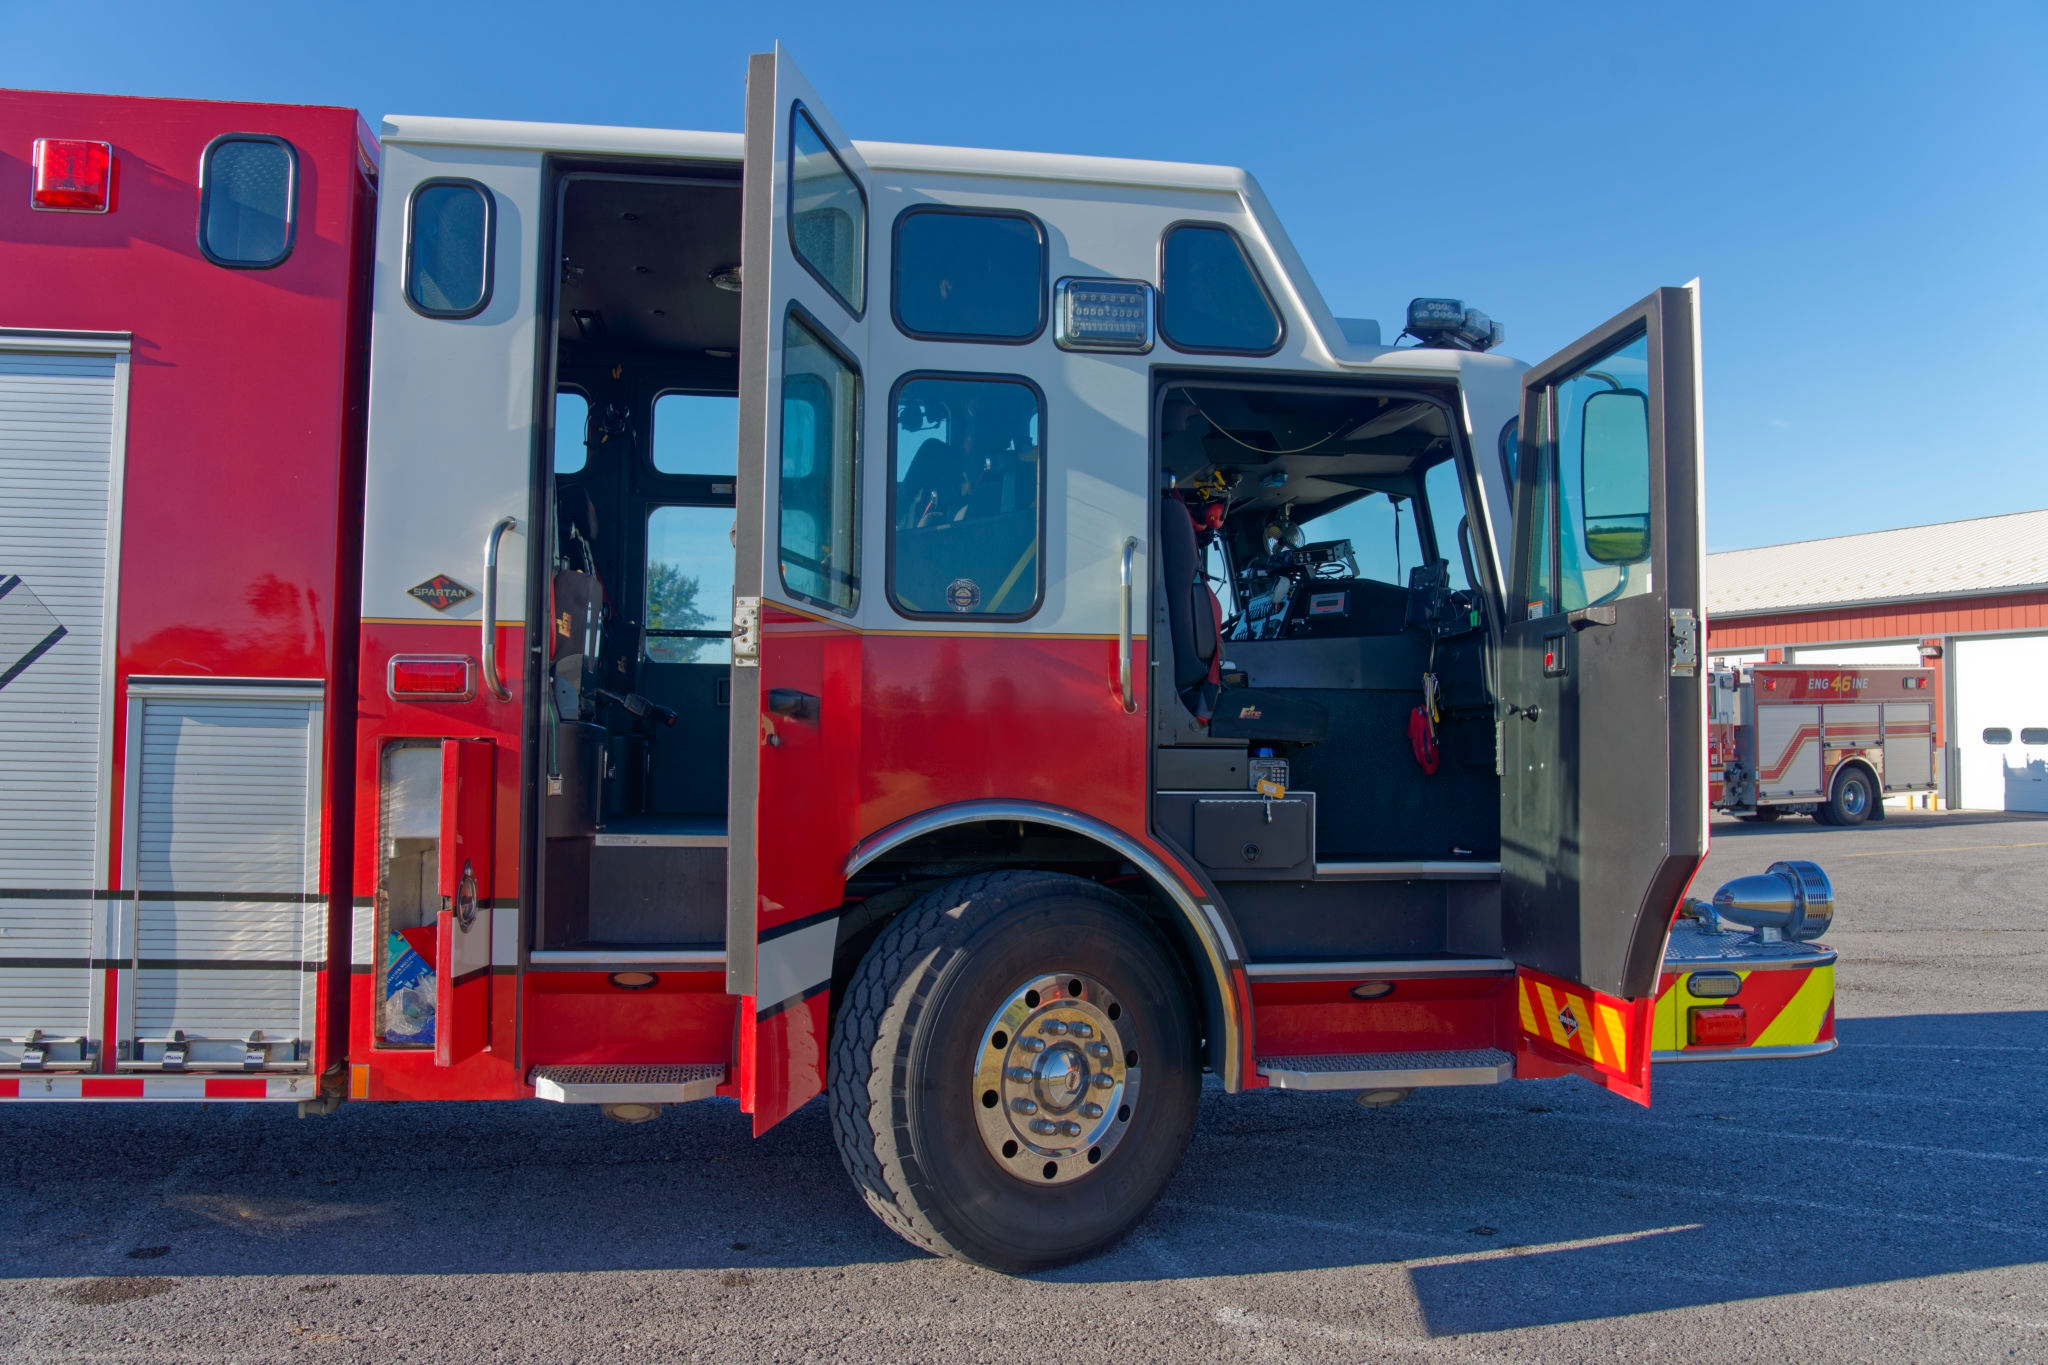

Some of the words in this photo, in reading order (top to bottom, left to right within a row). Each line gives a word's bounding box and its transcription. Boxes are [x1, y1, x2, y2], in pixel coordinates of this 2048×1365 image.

[413, 588, 467, 597] SPARTAN
[1808, 678, 1829, 690] ENG
[1830, 675, 1852, 692] 46
[1852, 677, 1869, 689] INE
